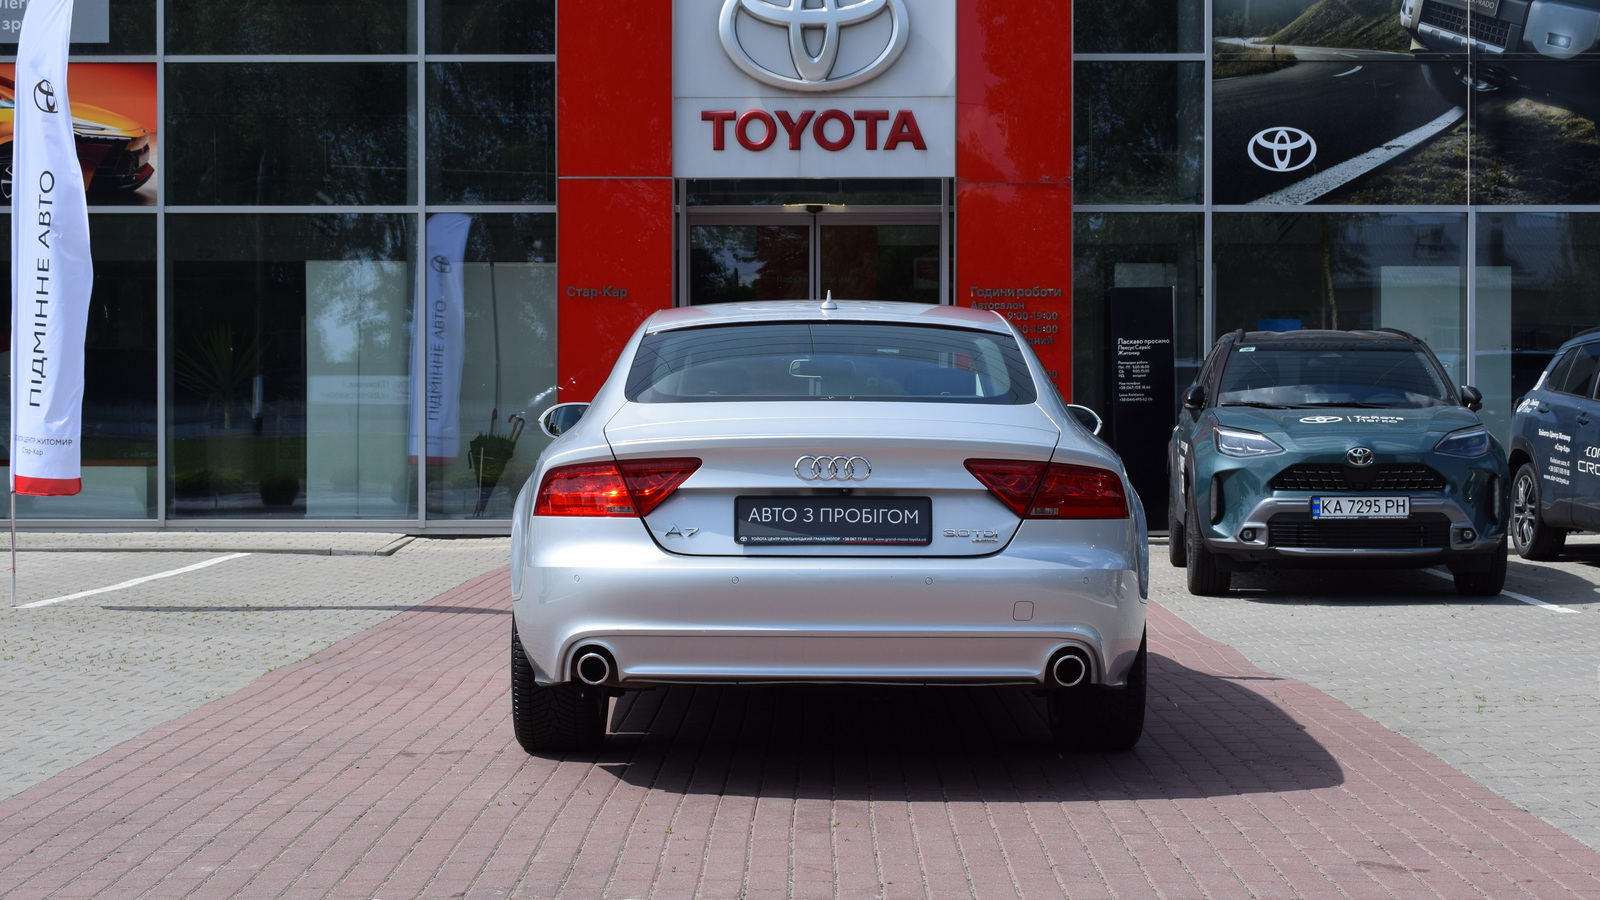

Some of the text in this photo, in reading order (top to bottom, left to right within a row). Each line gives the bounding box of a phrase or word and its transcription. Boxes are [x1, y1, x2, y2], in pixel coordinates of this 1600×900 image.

[701, 109, 927, 151] TOYOTA
[29, 170, 55, 407] ПІДМІННЕ АВТО
[566, 285, 628, 299] Стар-Кар
[970, 286, 1062, 299] Години роботи
[971, 301, 1025, 310] Автосалон
[433, 300, 447, 340] АВТО
[37, 438, 73, 446] ЖИТОМИР
[1322, 499, 1405, 514] KA 7295 PH
[748, 508, 919, 524] АВТО З ПРОБІГОМ
[665, 523, 699, 538] A7
[972, 529, 998, 538] TDI
